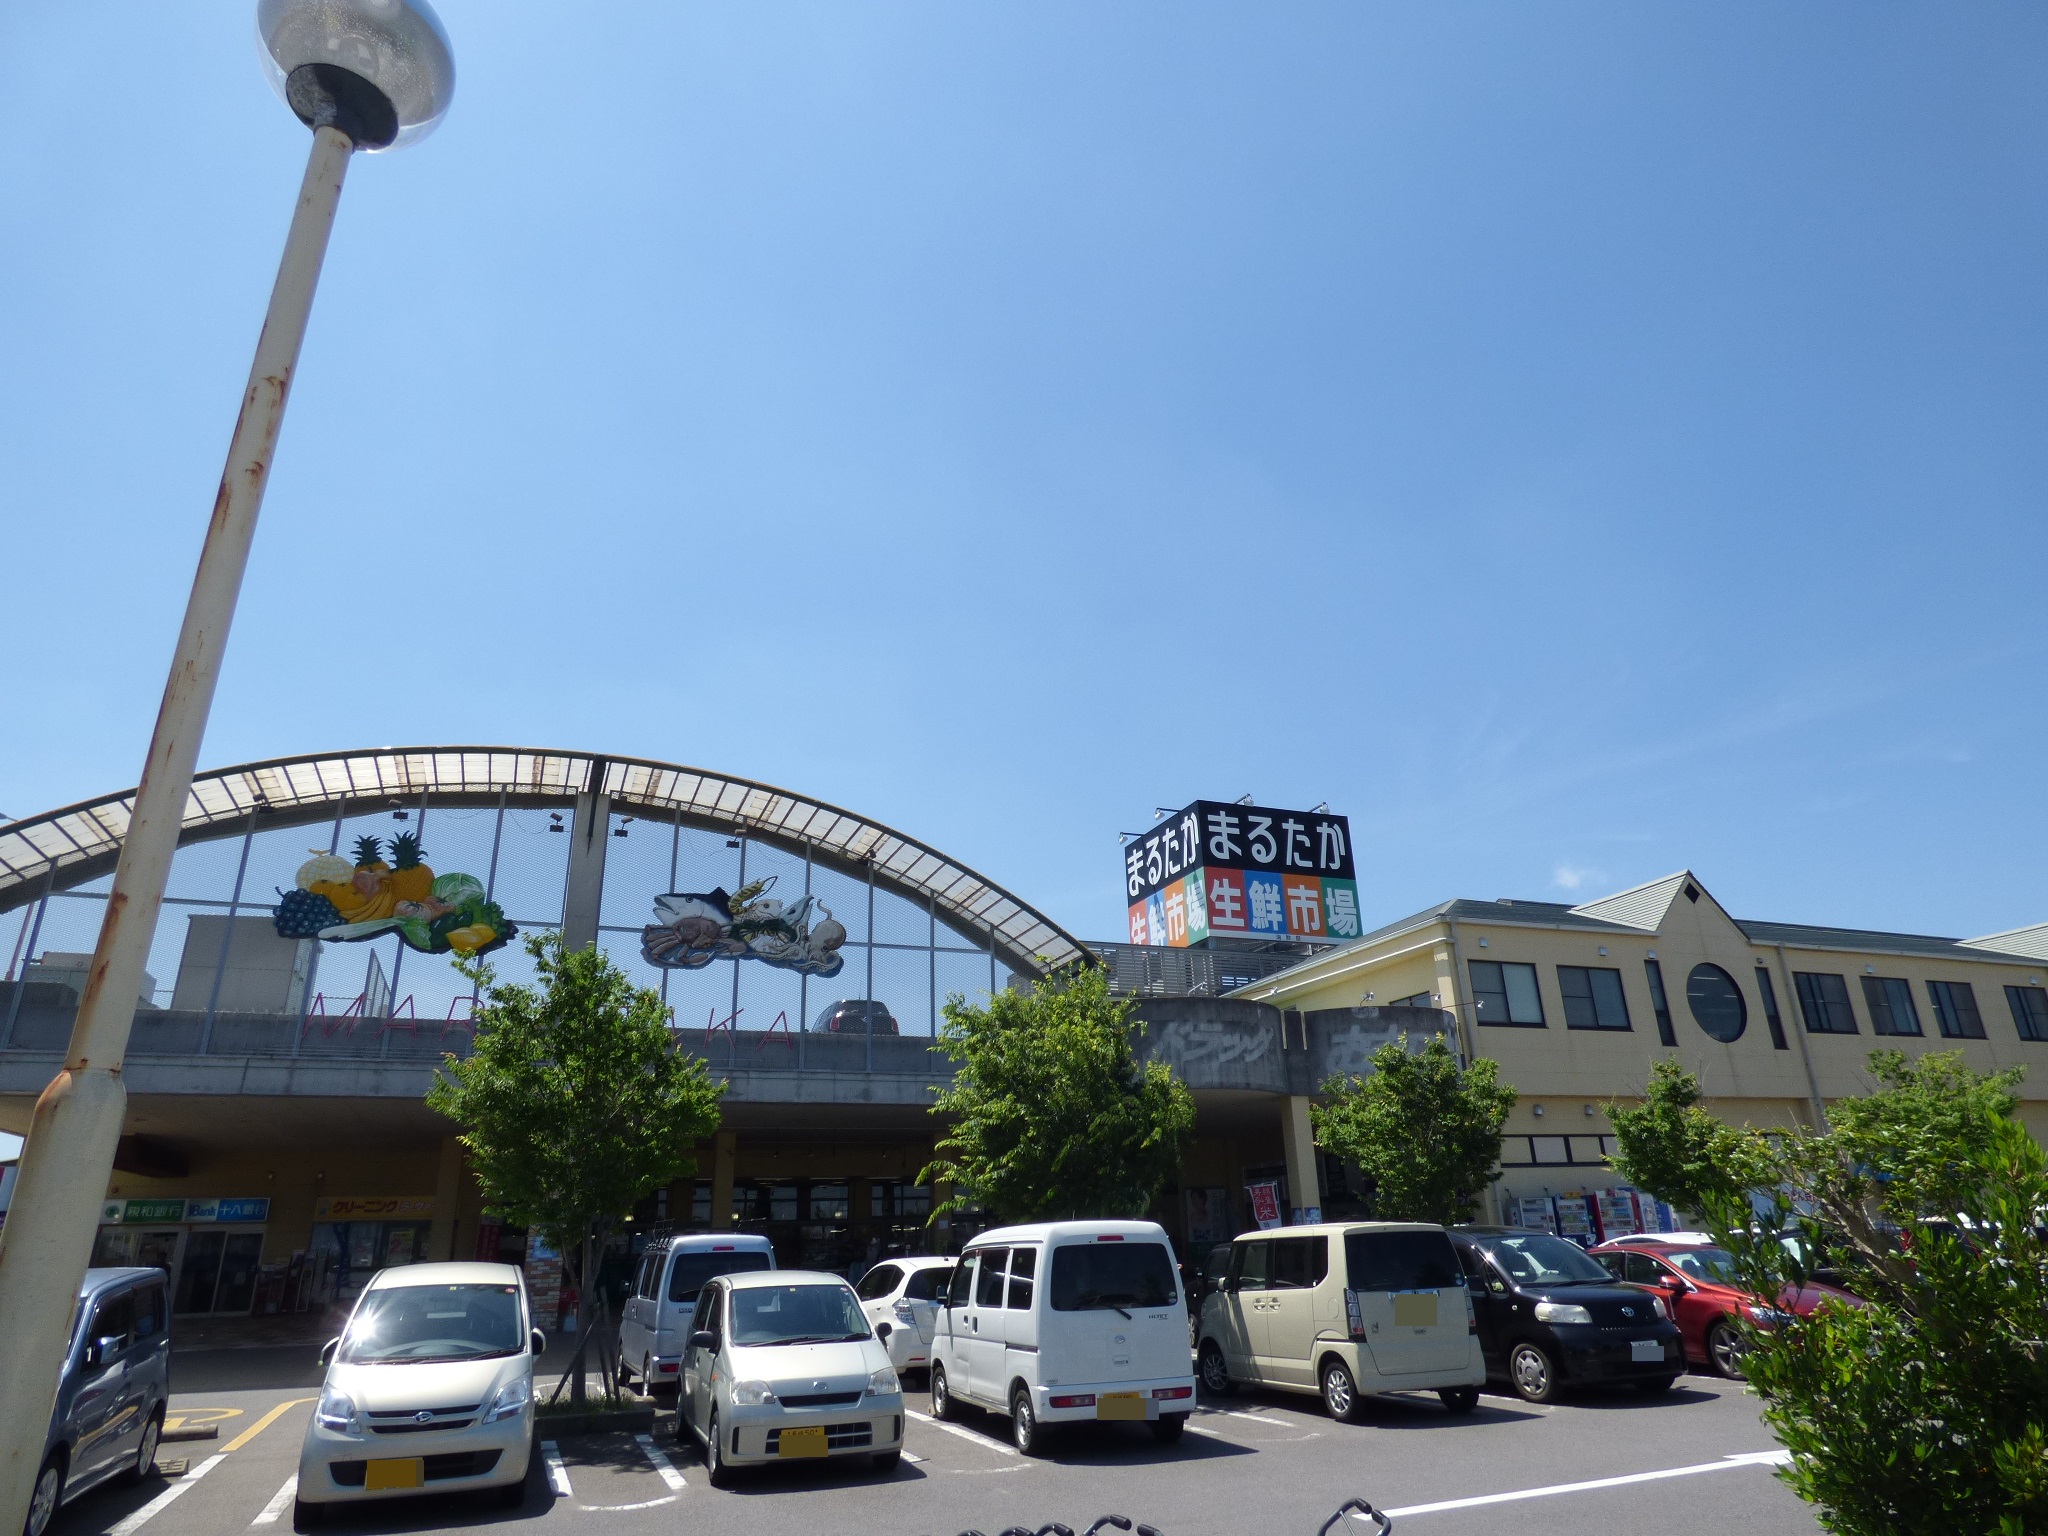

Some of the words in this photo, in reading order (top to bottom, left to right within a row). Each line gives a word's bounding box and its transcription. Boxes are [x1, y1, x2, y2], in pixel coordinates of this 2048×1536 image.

[1127, 812, 1199, 897] まるたか
[1207, 810, 1346, 870] まるたか
[1131, 879, 1206, 946] 生鮮市場
[1209, 878, 1358, 937] 生鮮市場
[127, 1205, 182, 1217] 親和銀行
[218, 1204, 266, 1216] 十八銀行
[333, 1200, 398, 1213] クリーニング
